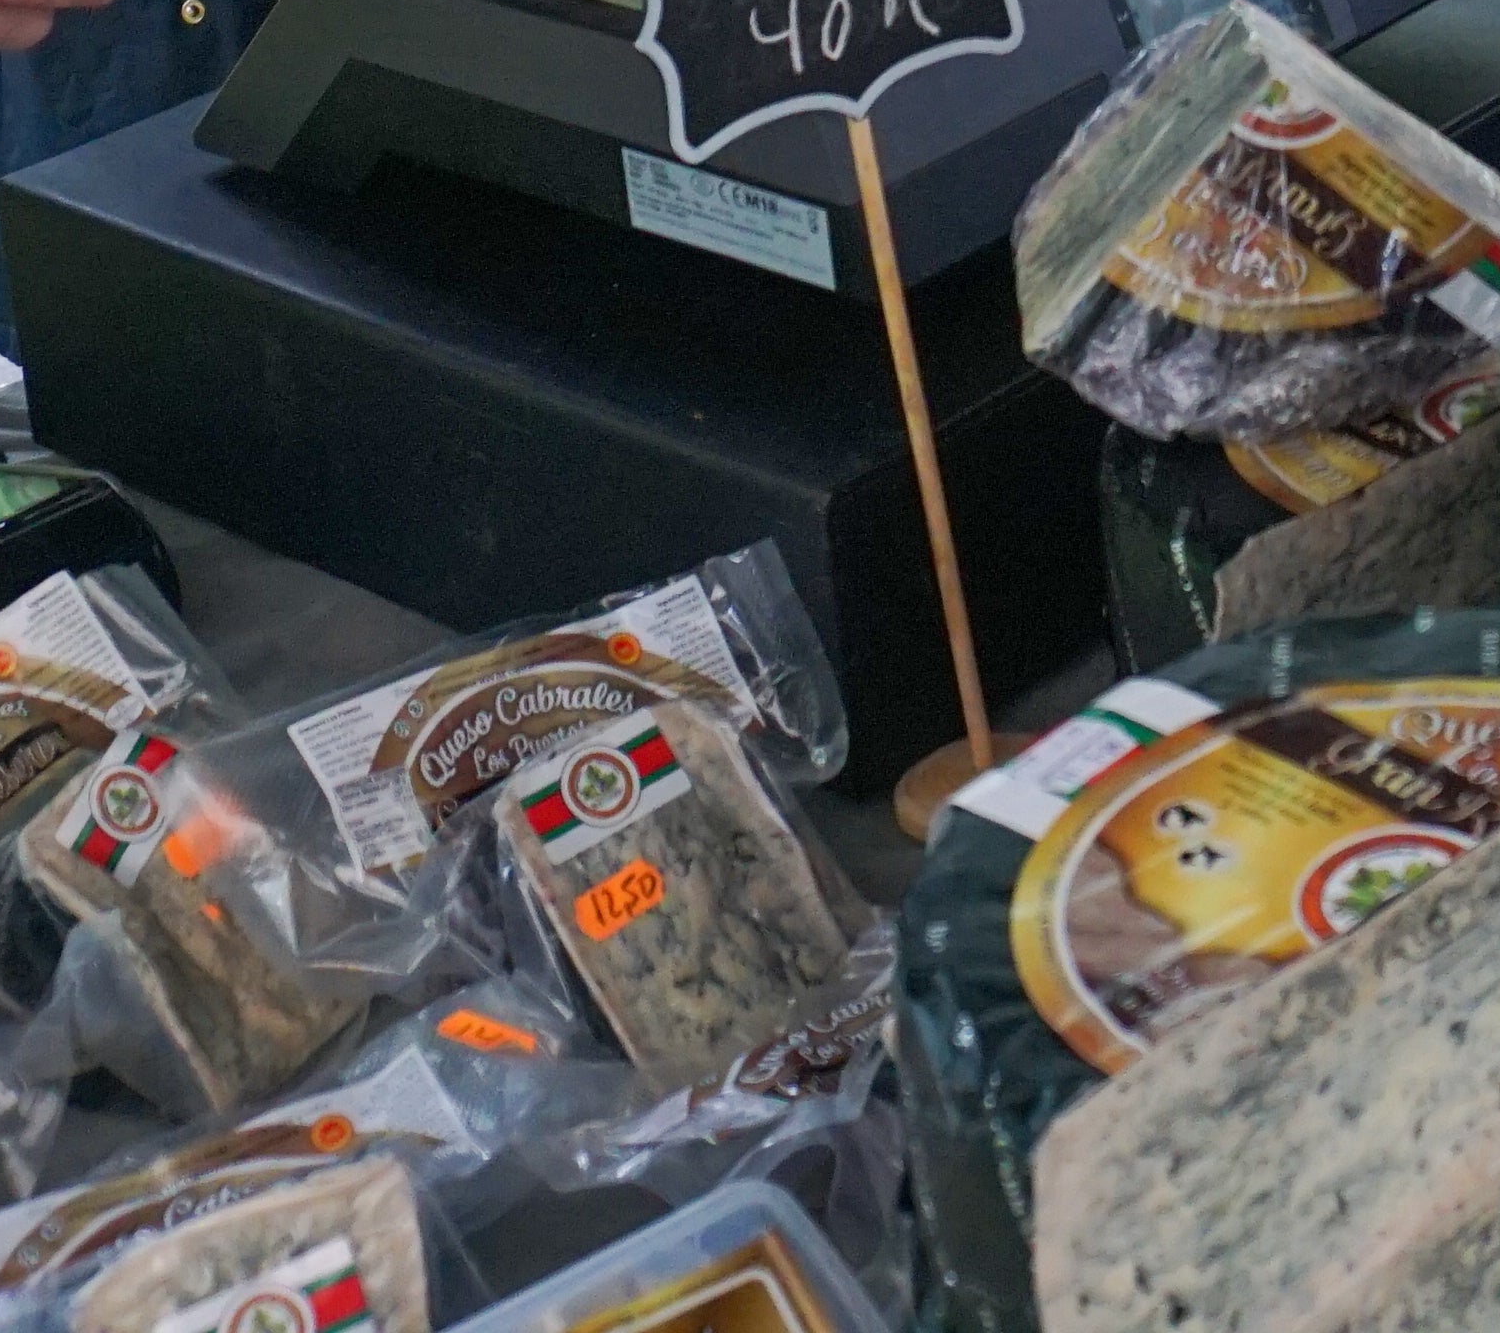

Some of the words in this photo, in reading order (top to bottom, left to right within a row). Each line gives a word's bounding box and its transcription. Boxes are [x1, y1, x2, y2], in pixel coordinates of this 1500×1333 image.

[419, 710, 493, 788] Queso
[495, 683, 636, 726] Cabrales
[473, 748, 510, 781] Los
[589, 872, 658, 928] 12,50
